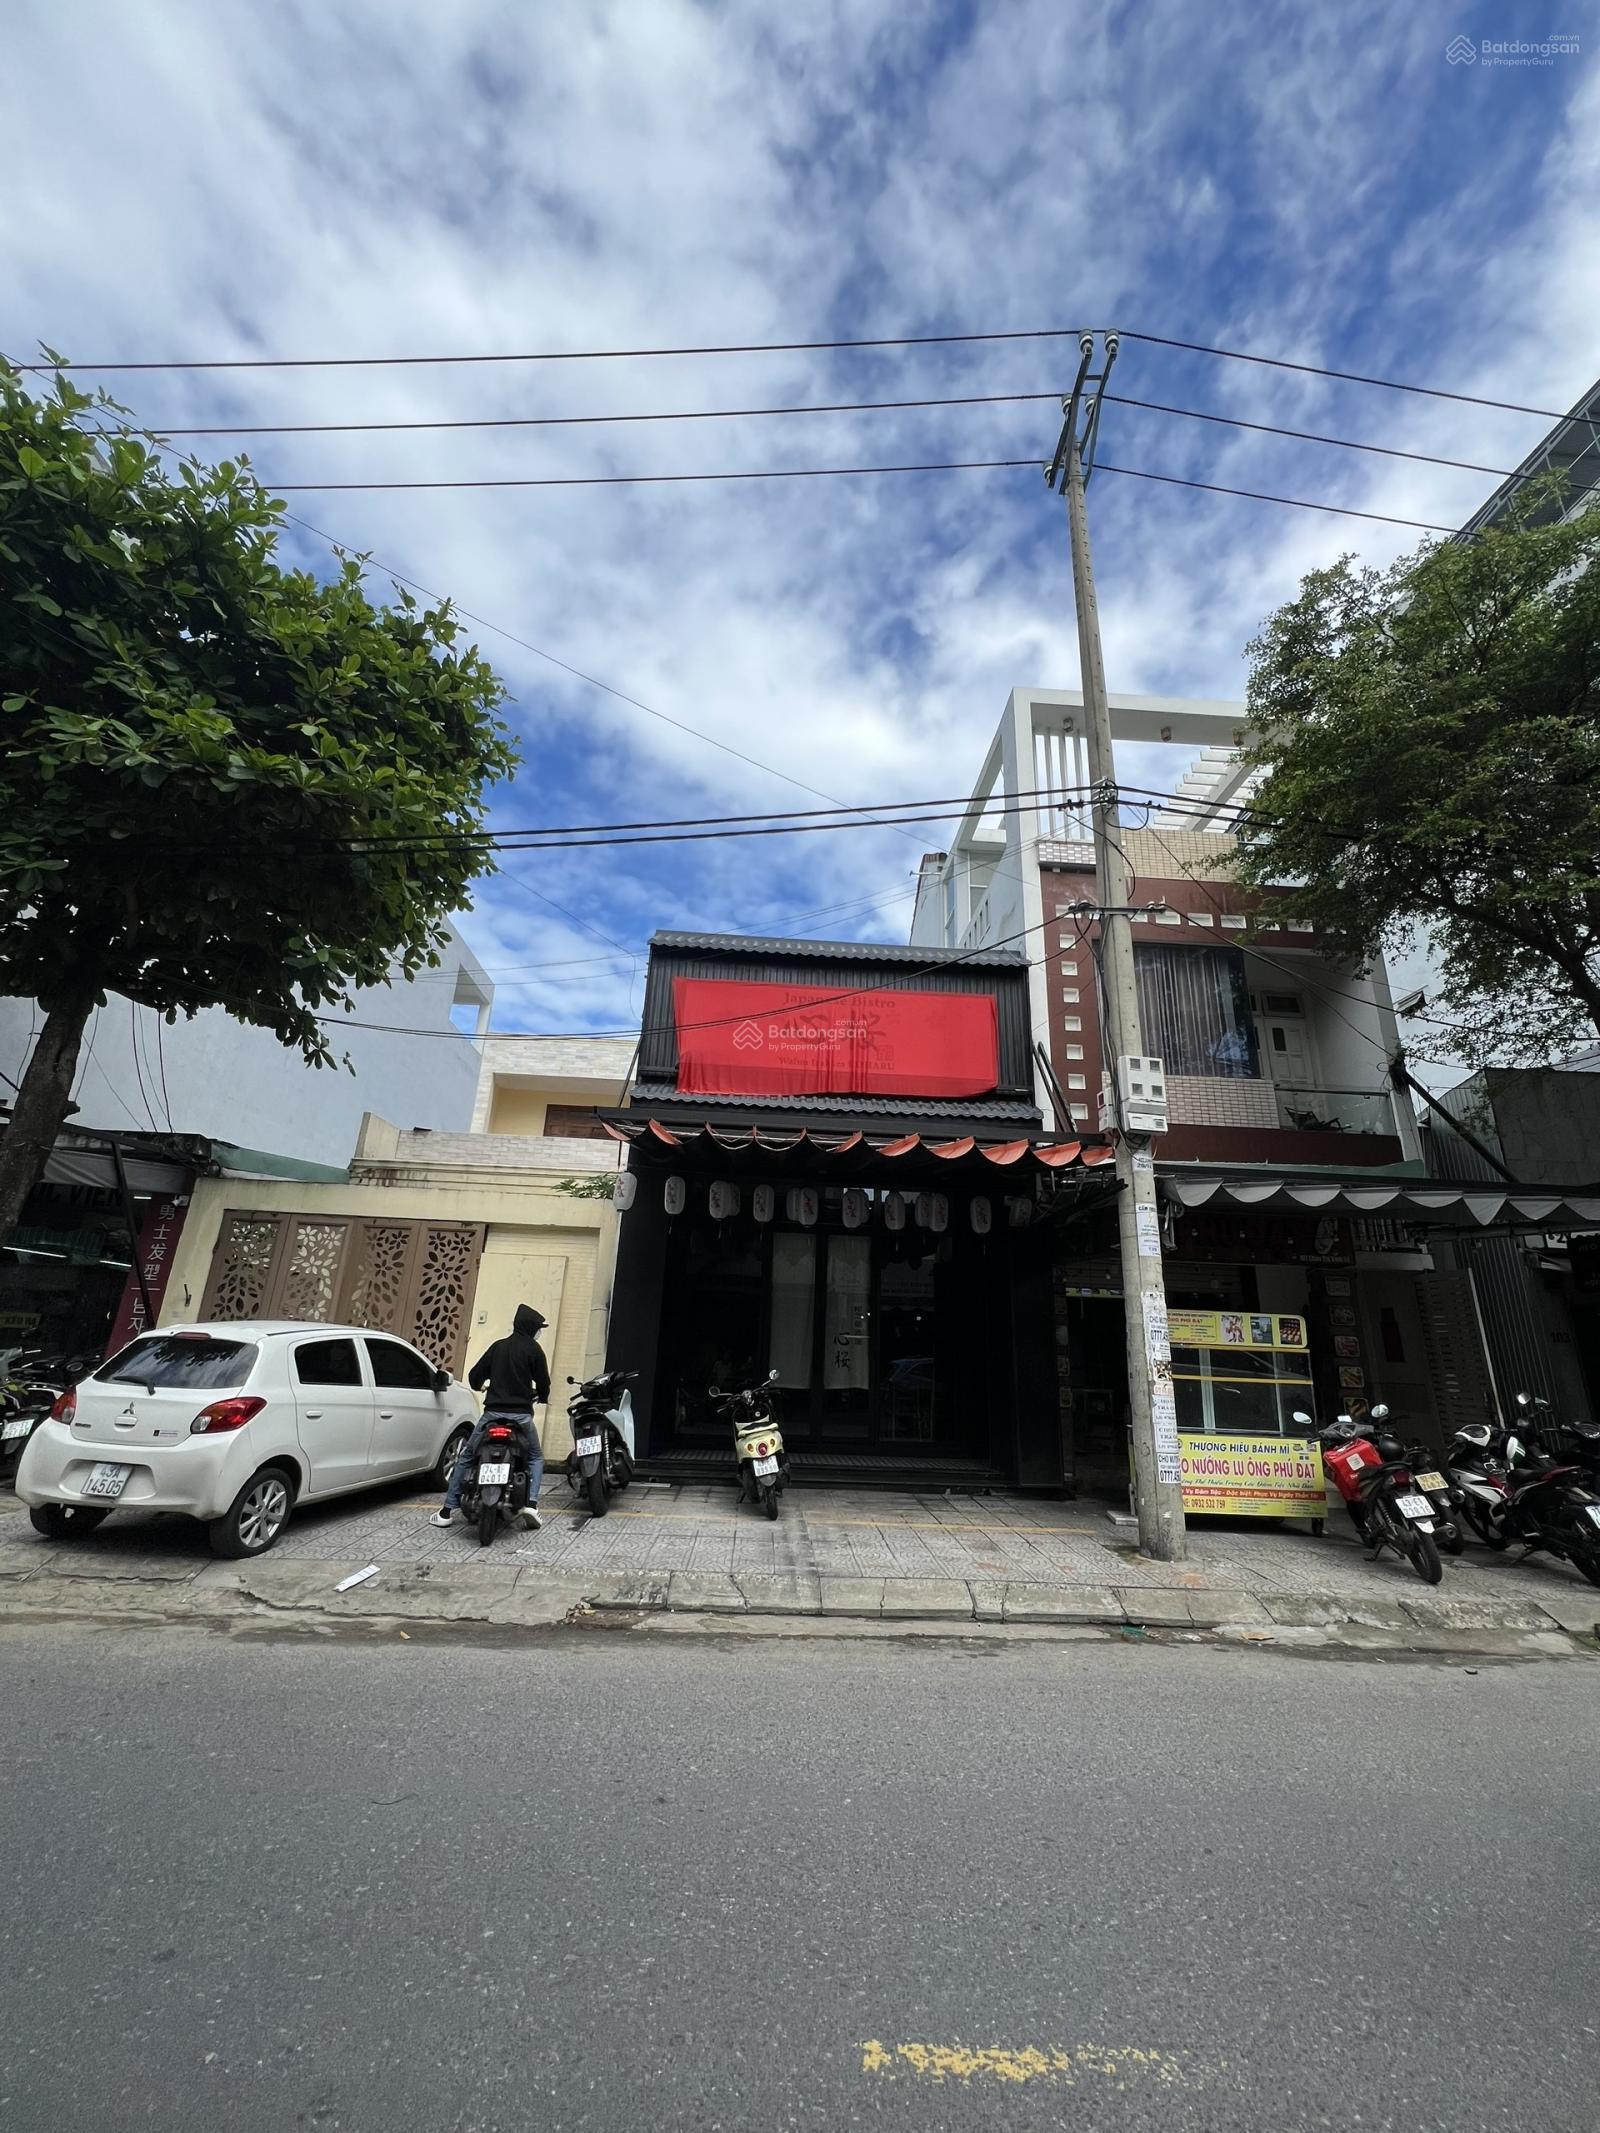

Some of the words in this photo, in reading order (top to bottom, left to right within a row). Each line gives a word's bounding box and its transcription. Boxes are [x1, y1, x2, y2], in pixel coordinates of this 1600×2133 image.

[143, 1203, 176, 1281] 男士发型
[1189, 1441, 1227, 1452] THƯƠNG
[1229, 1441, 1250, 1456] HIỆU
[1252, 1442, 1277, 1454] BÁNH
[1279, 1444, 1290, 1455] MÌ
[100, 1464, 121, 1479] 43A
[1192, 1455, 1230, 1475] NƯỚNG
[1233, 1460, 1244, 1476] LU
[1247, 1457, 1271, 1477] ÔNG
[1273, 1458, 1294, 1478] PHÚ
[1296, 1462, 1316, 1483] ĐẠT
